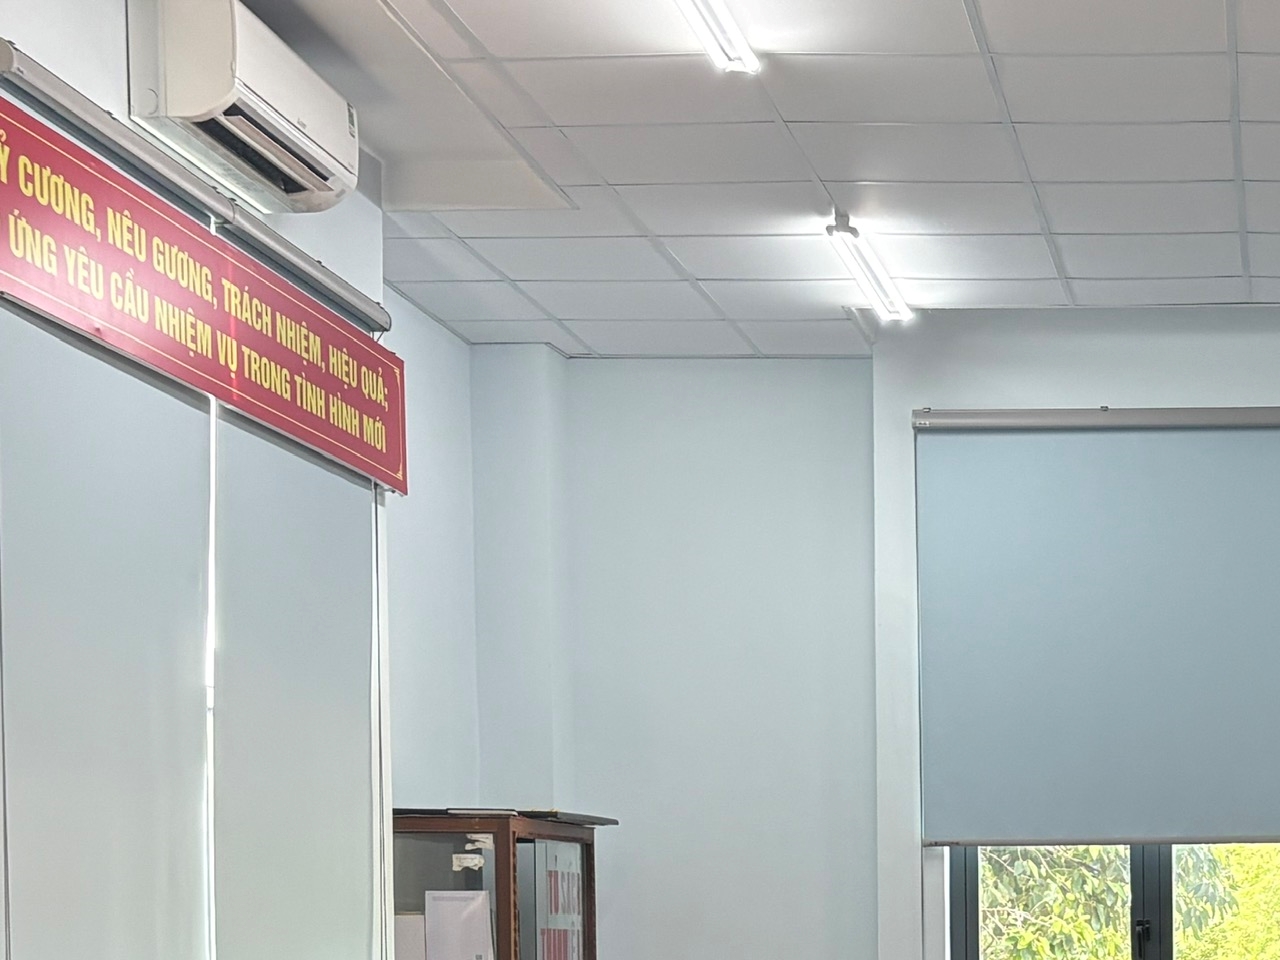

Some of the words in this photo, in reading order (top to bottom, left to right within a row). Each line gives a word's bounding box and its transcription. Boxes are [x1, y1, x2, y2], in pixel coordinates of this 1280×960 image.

[8, 209, 57, 275] ỨNG
[63, 243, 103, 299] YÊU
[110, 267, 150, 324] CẦU
[154, 299, 212, 359] NHIỆM
[216, 330, 237, 379] VỤ
[242, 345, 291, 402] TRONG
[294, 372, 325, 420] TÌNH
[329, 393, 360, 438] HÌNH
[363, 413, 387, 454] MỚI
[18, 155, 101, 243] CƯƠNG,
[107, 206, 146, 263] NÊU
[152, 236, 218, 310] GƯƠNG,
[221, 277, 272, 338] TRÁCH
[276, 321, 325, 372] NHIỆM,
[329, 346, 357, 390] HIỆU
[361, 366, 389, 412] QUẢ;
